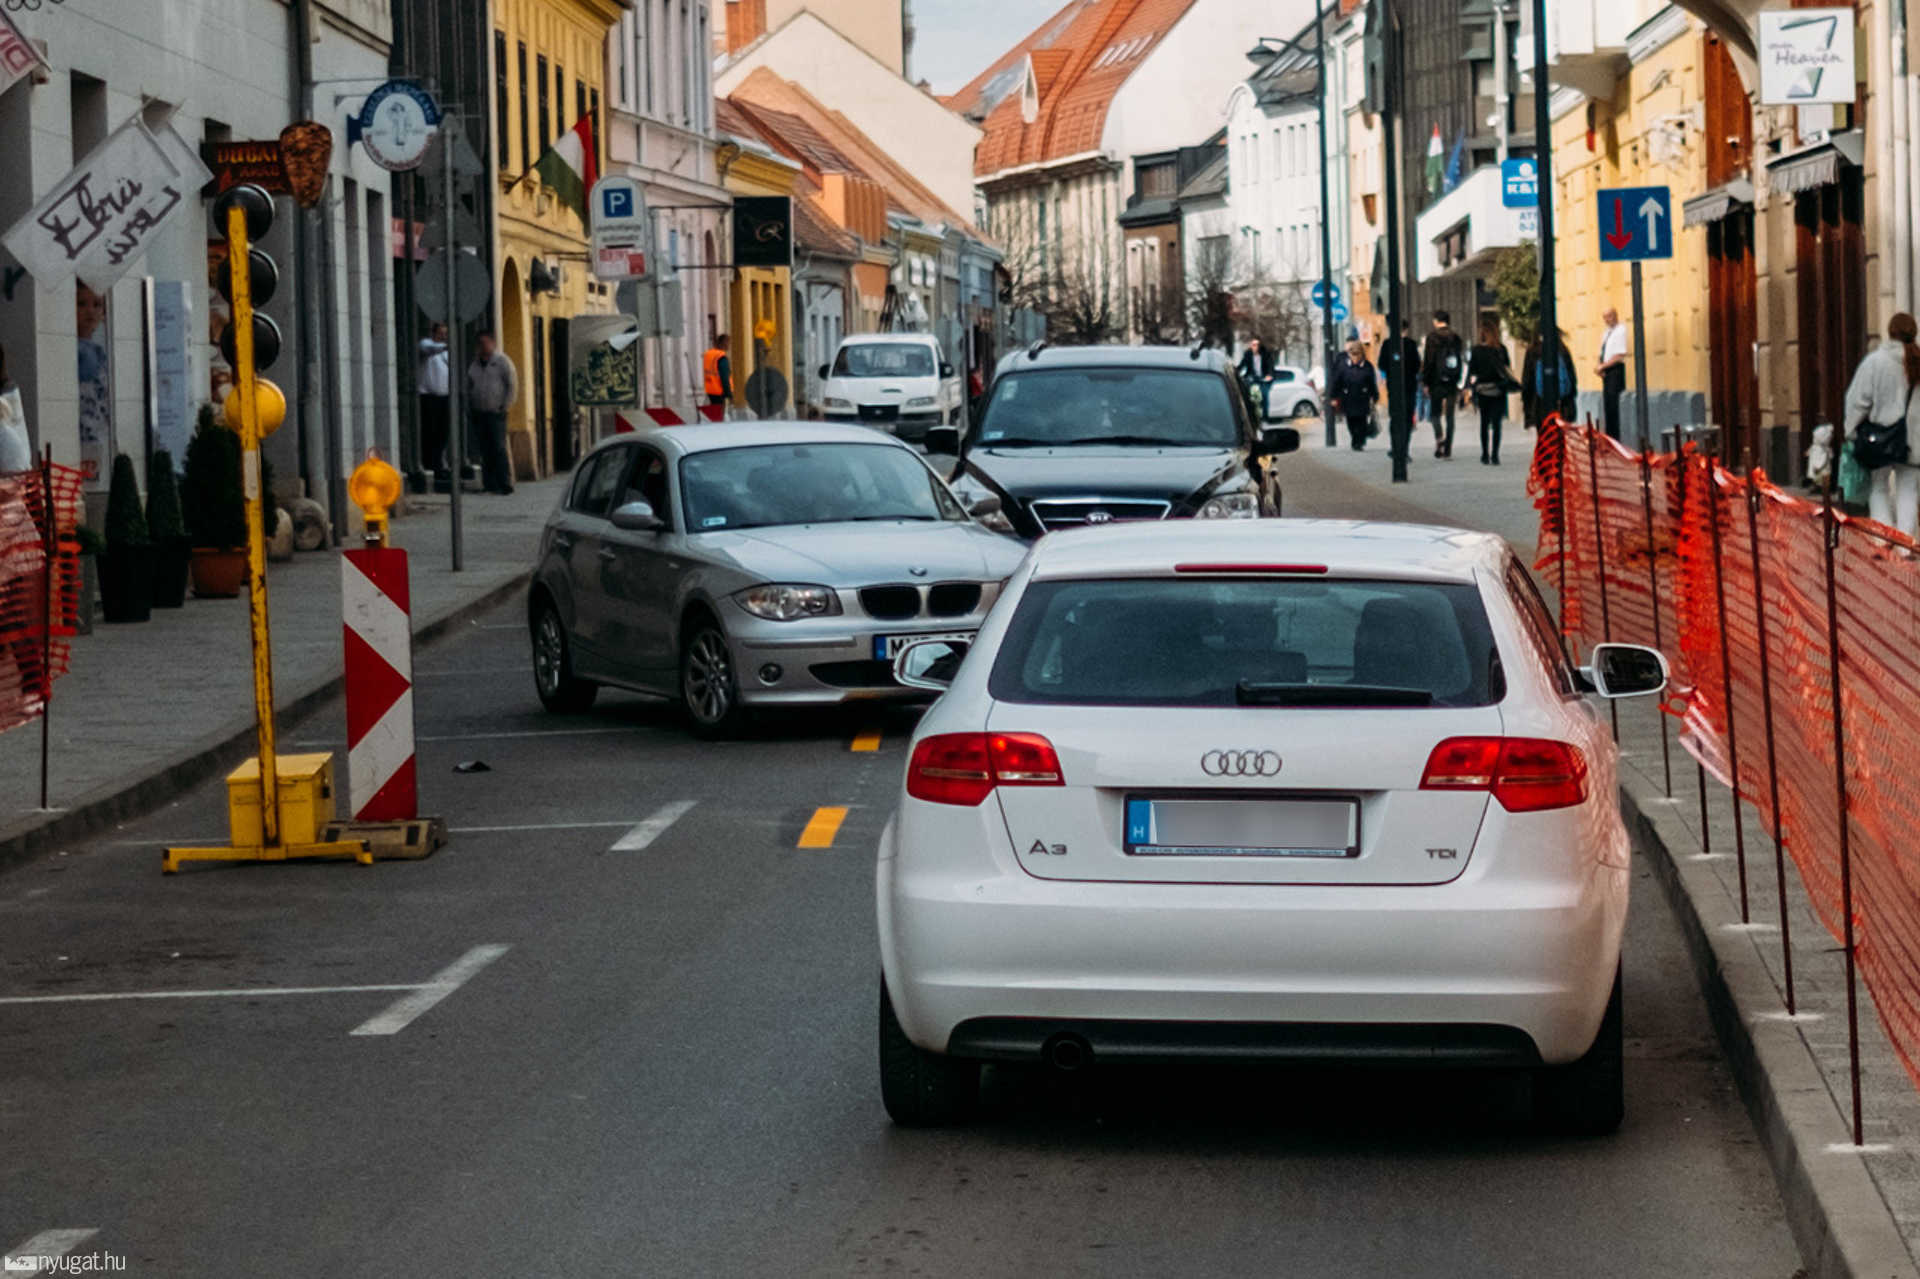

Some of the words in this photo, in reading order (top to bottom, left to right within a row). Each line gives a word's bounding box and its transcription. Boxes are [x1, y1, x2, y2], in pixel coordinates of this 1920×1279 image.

[1775, 48, 1844, 65] Heaven
[609, 192, 627, 214] P
[1133, 825, 1145, 839] H
[1028, 839, 1068, 856] A3
[1424, 848, 1457, 860] TDI
